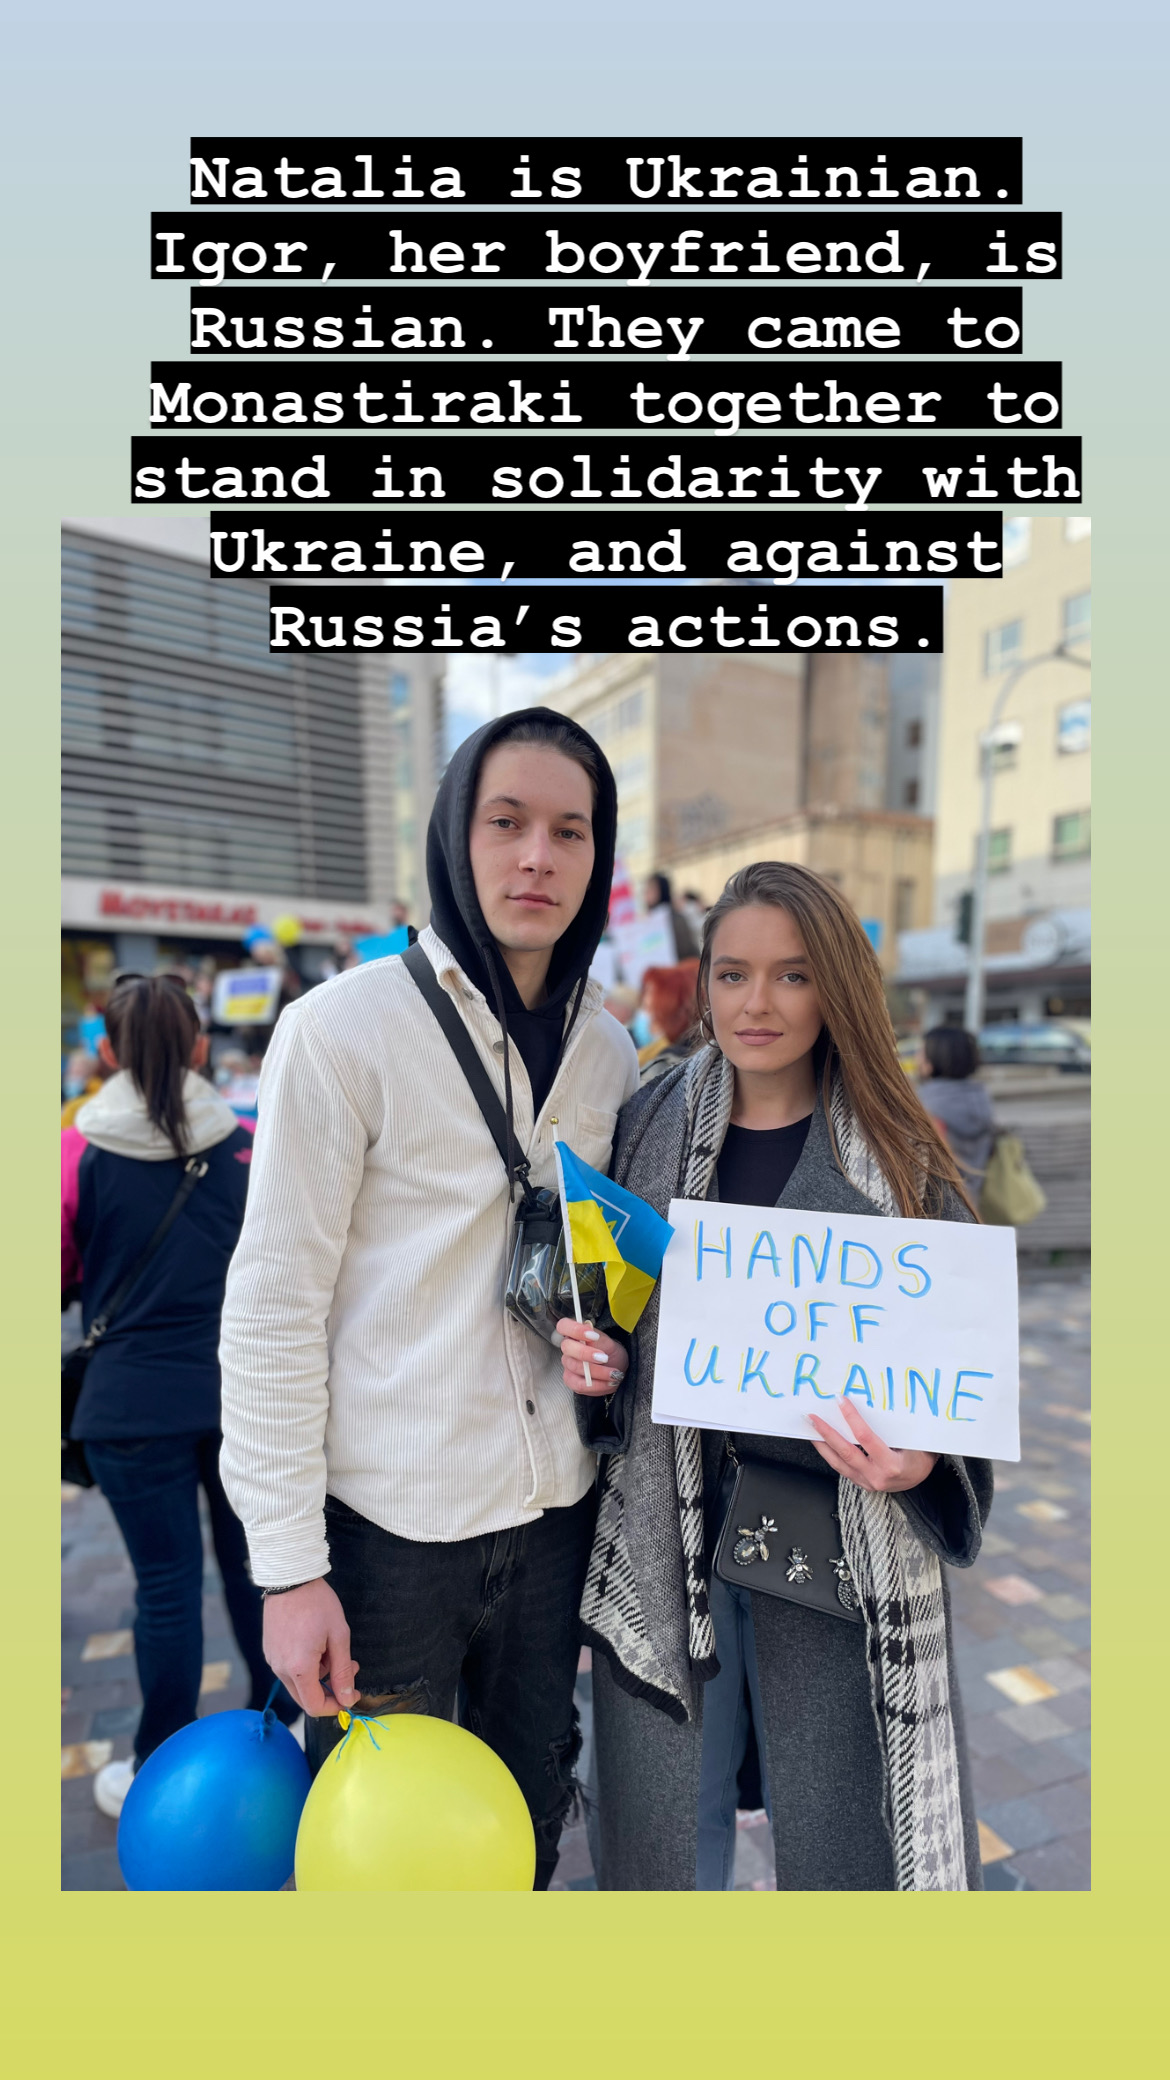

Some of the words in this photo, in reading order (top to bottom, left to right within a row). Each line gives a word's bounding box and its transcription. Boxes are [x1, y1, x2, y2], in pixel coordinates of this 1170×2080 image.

[694, 1219, 932, 1298] HANDS
[764, 1299, 887, 1343] OFF
[684, 1337, 994, 1422] UKRAINE
